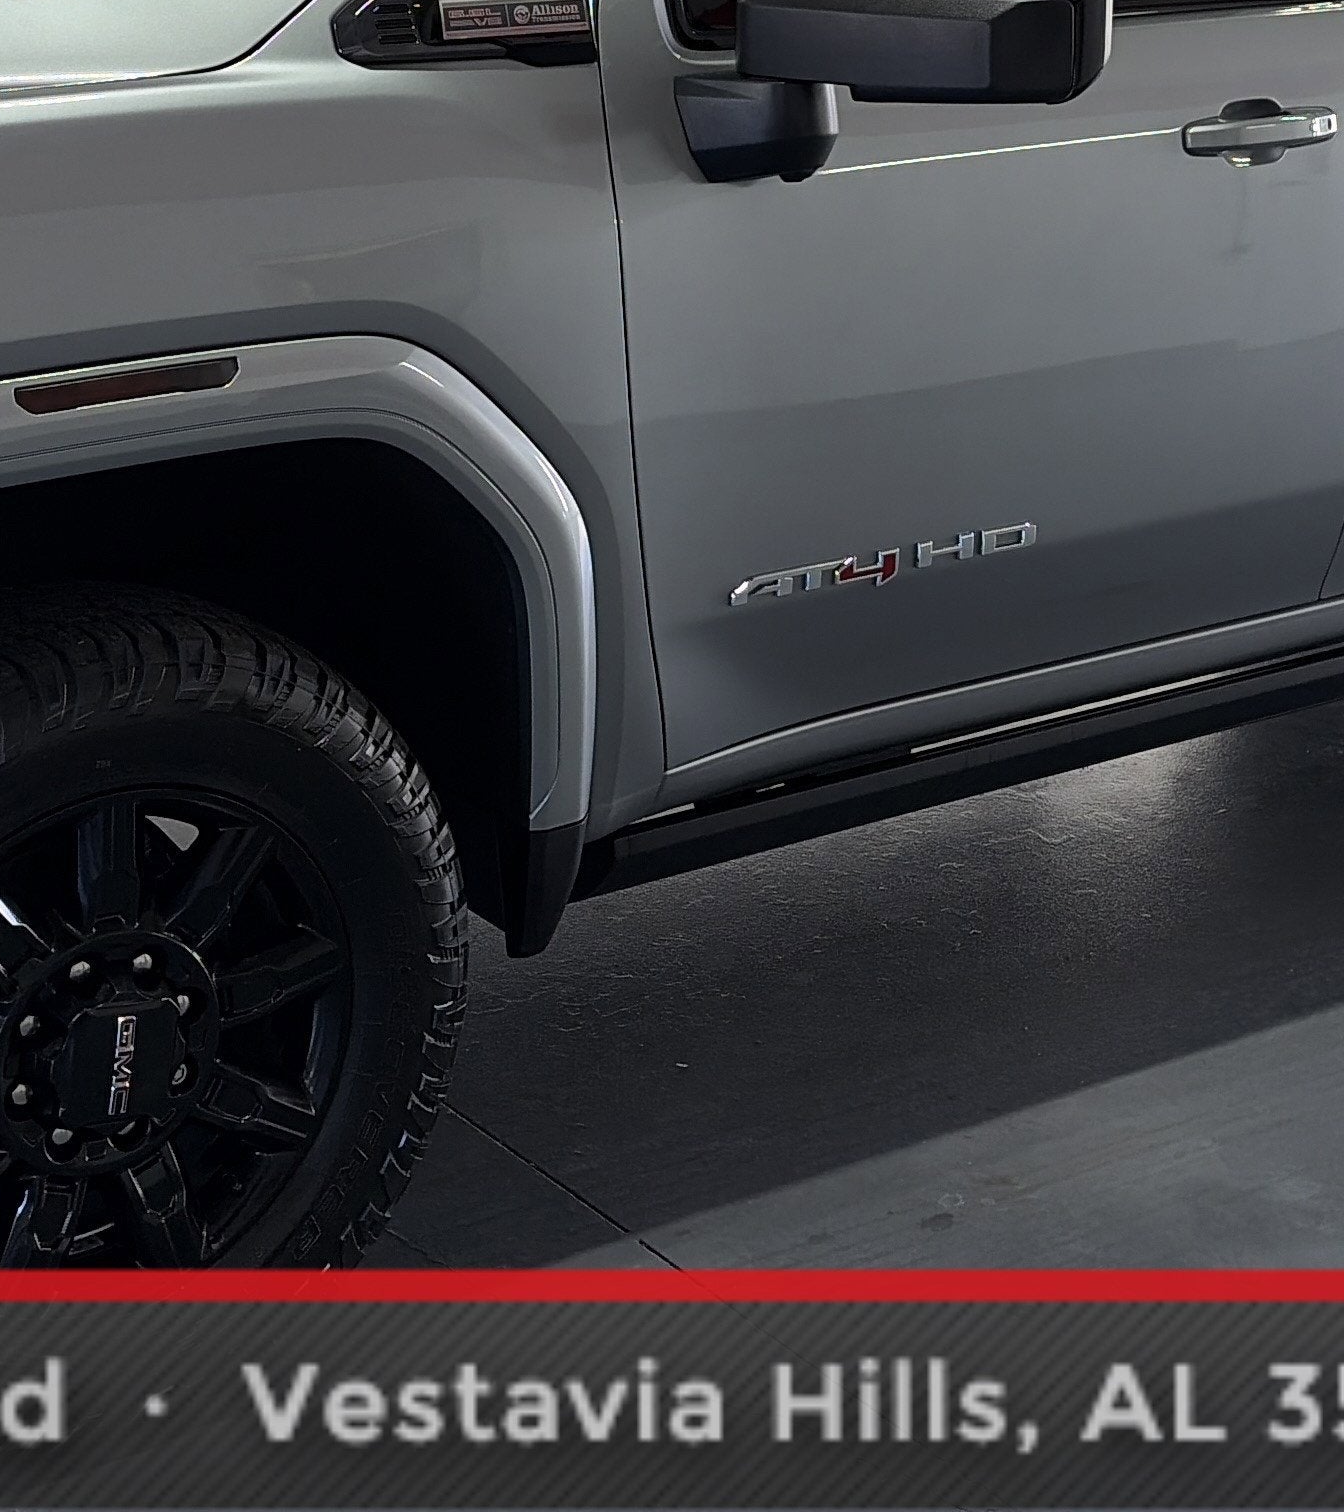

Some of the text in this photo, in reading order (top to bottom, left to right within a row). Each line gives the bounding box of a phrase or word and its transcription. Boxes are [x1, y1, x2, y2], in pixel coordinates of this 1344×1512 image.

[531, 4, 579, 16] Allison
[730, 522, 1038, 607] AT4 HD
[107, 1015, 137, 1116] GMC
